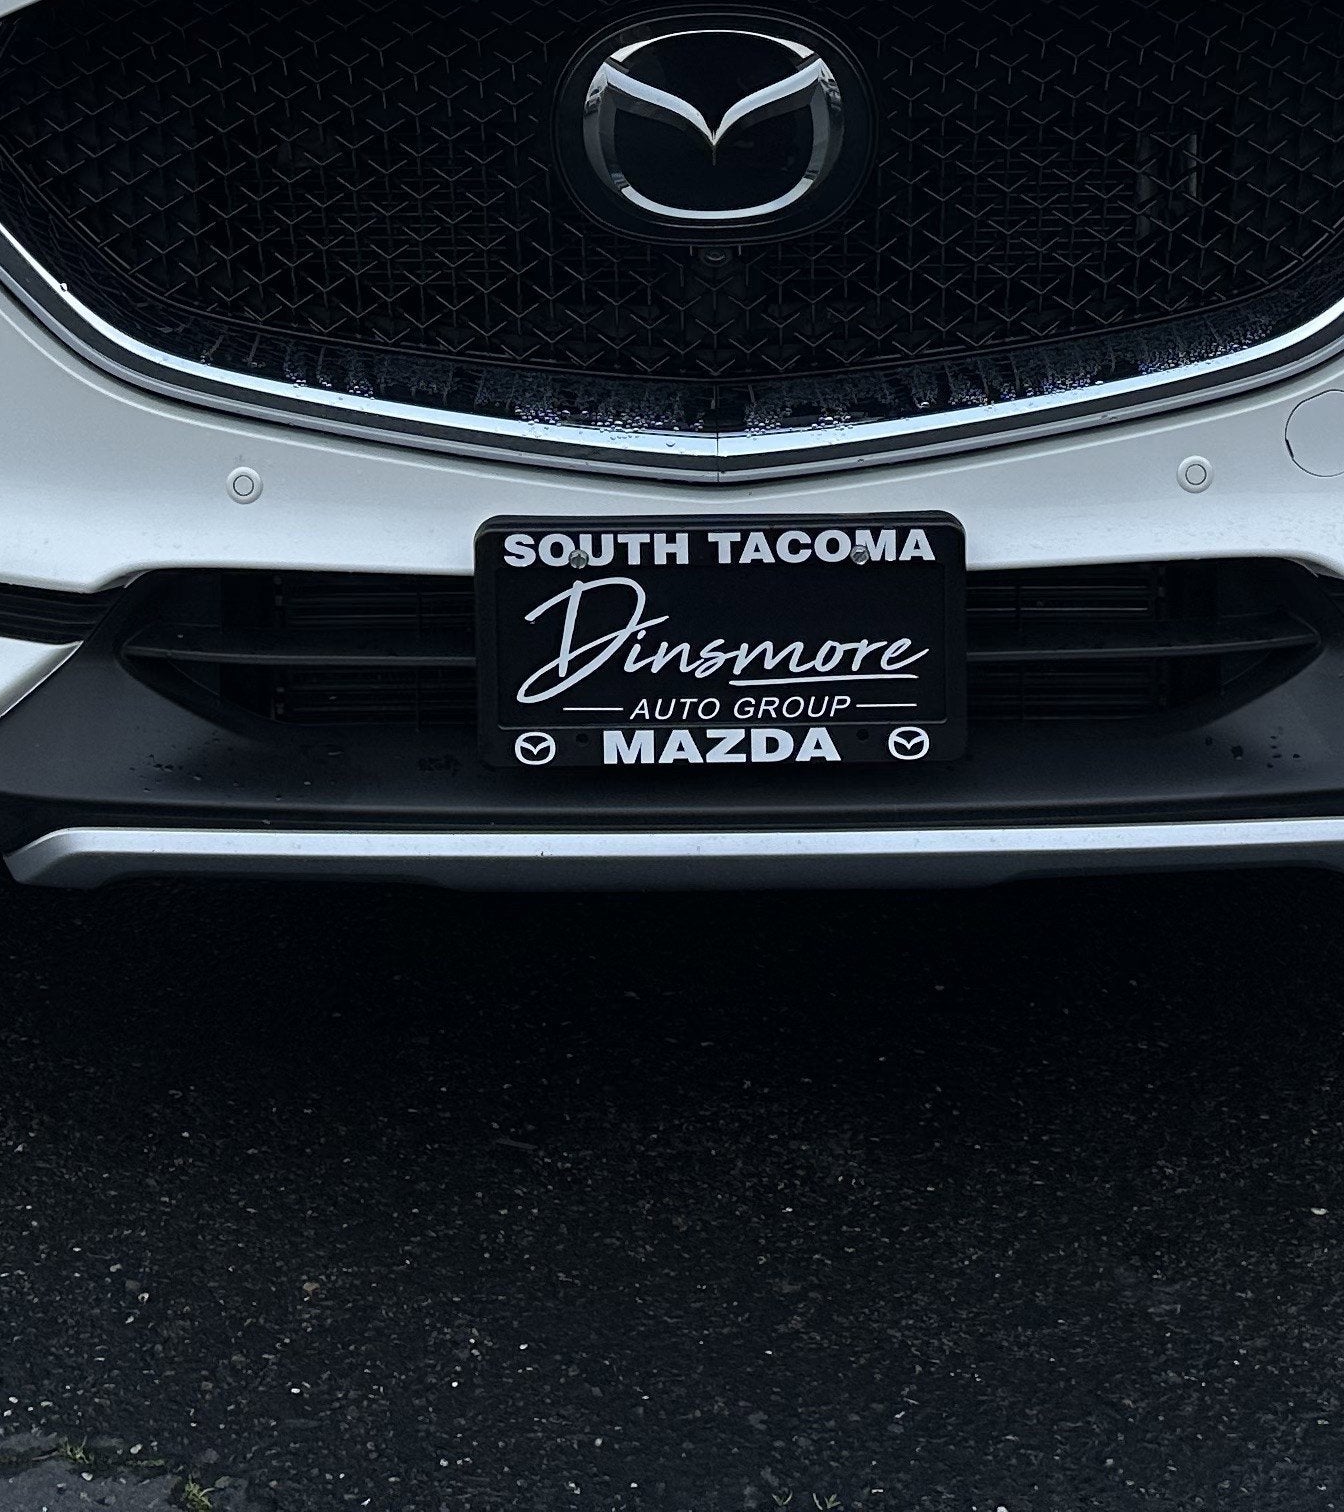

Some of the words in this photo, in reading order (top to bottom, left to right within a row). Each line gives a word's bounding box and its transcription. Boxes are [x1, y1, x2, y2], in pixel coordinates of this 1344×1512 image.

[504, 532, 689, 567] SOUTH
[707, 528, 936, 564] TACOMA
[516, 576, 930, 704] Dinsmore
[629, 697, 721, 720] AUTO
[733, 695, 851, 719] GROUP
[603, 726, 842, 765] MAZDA
